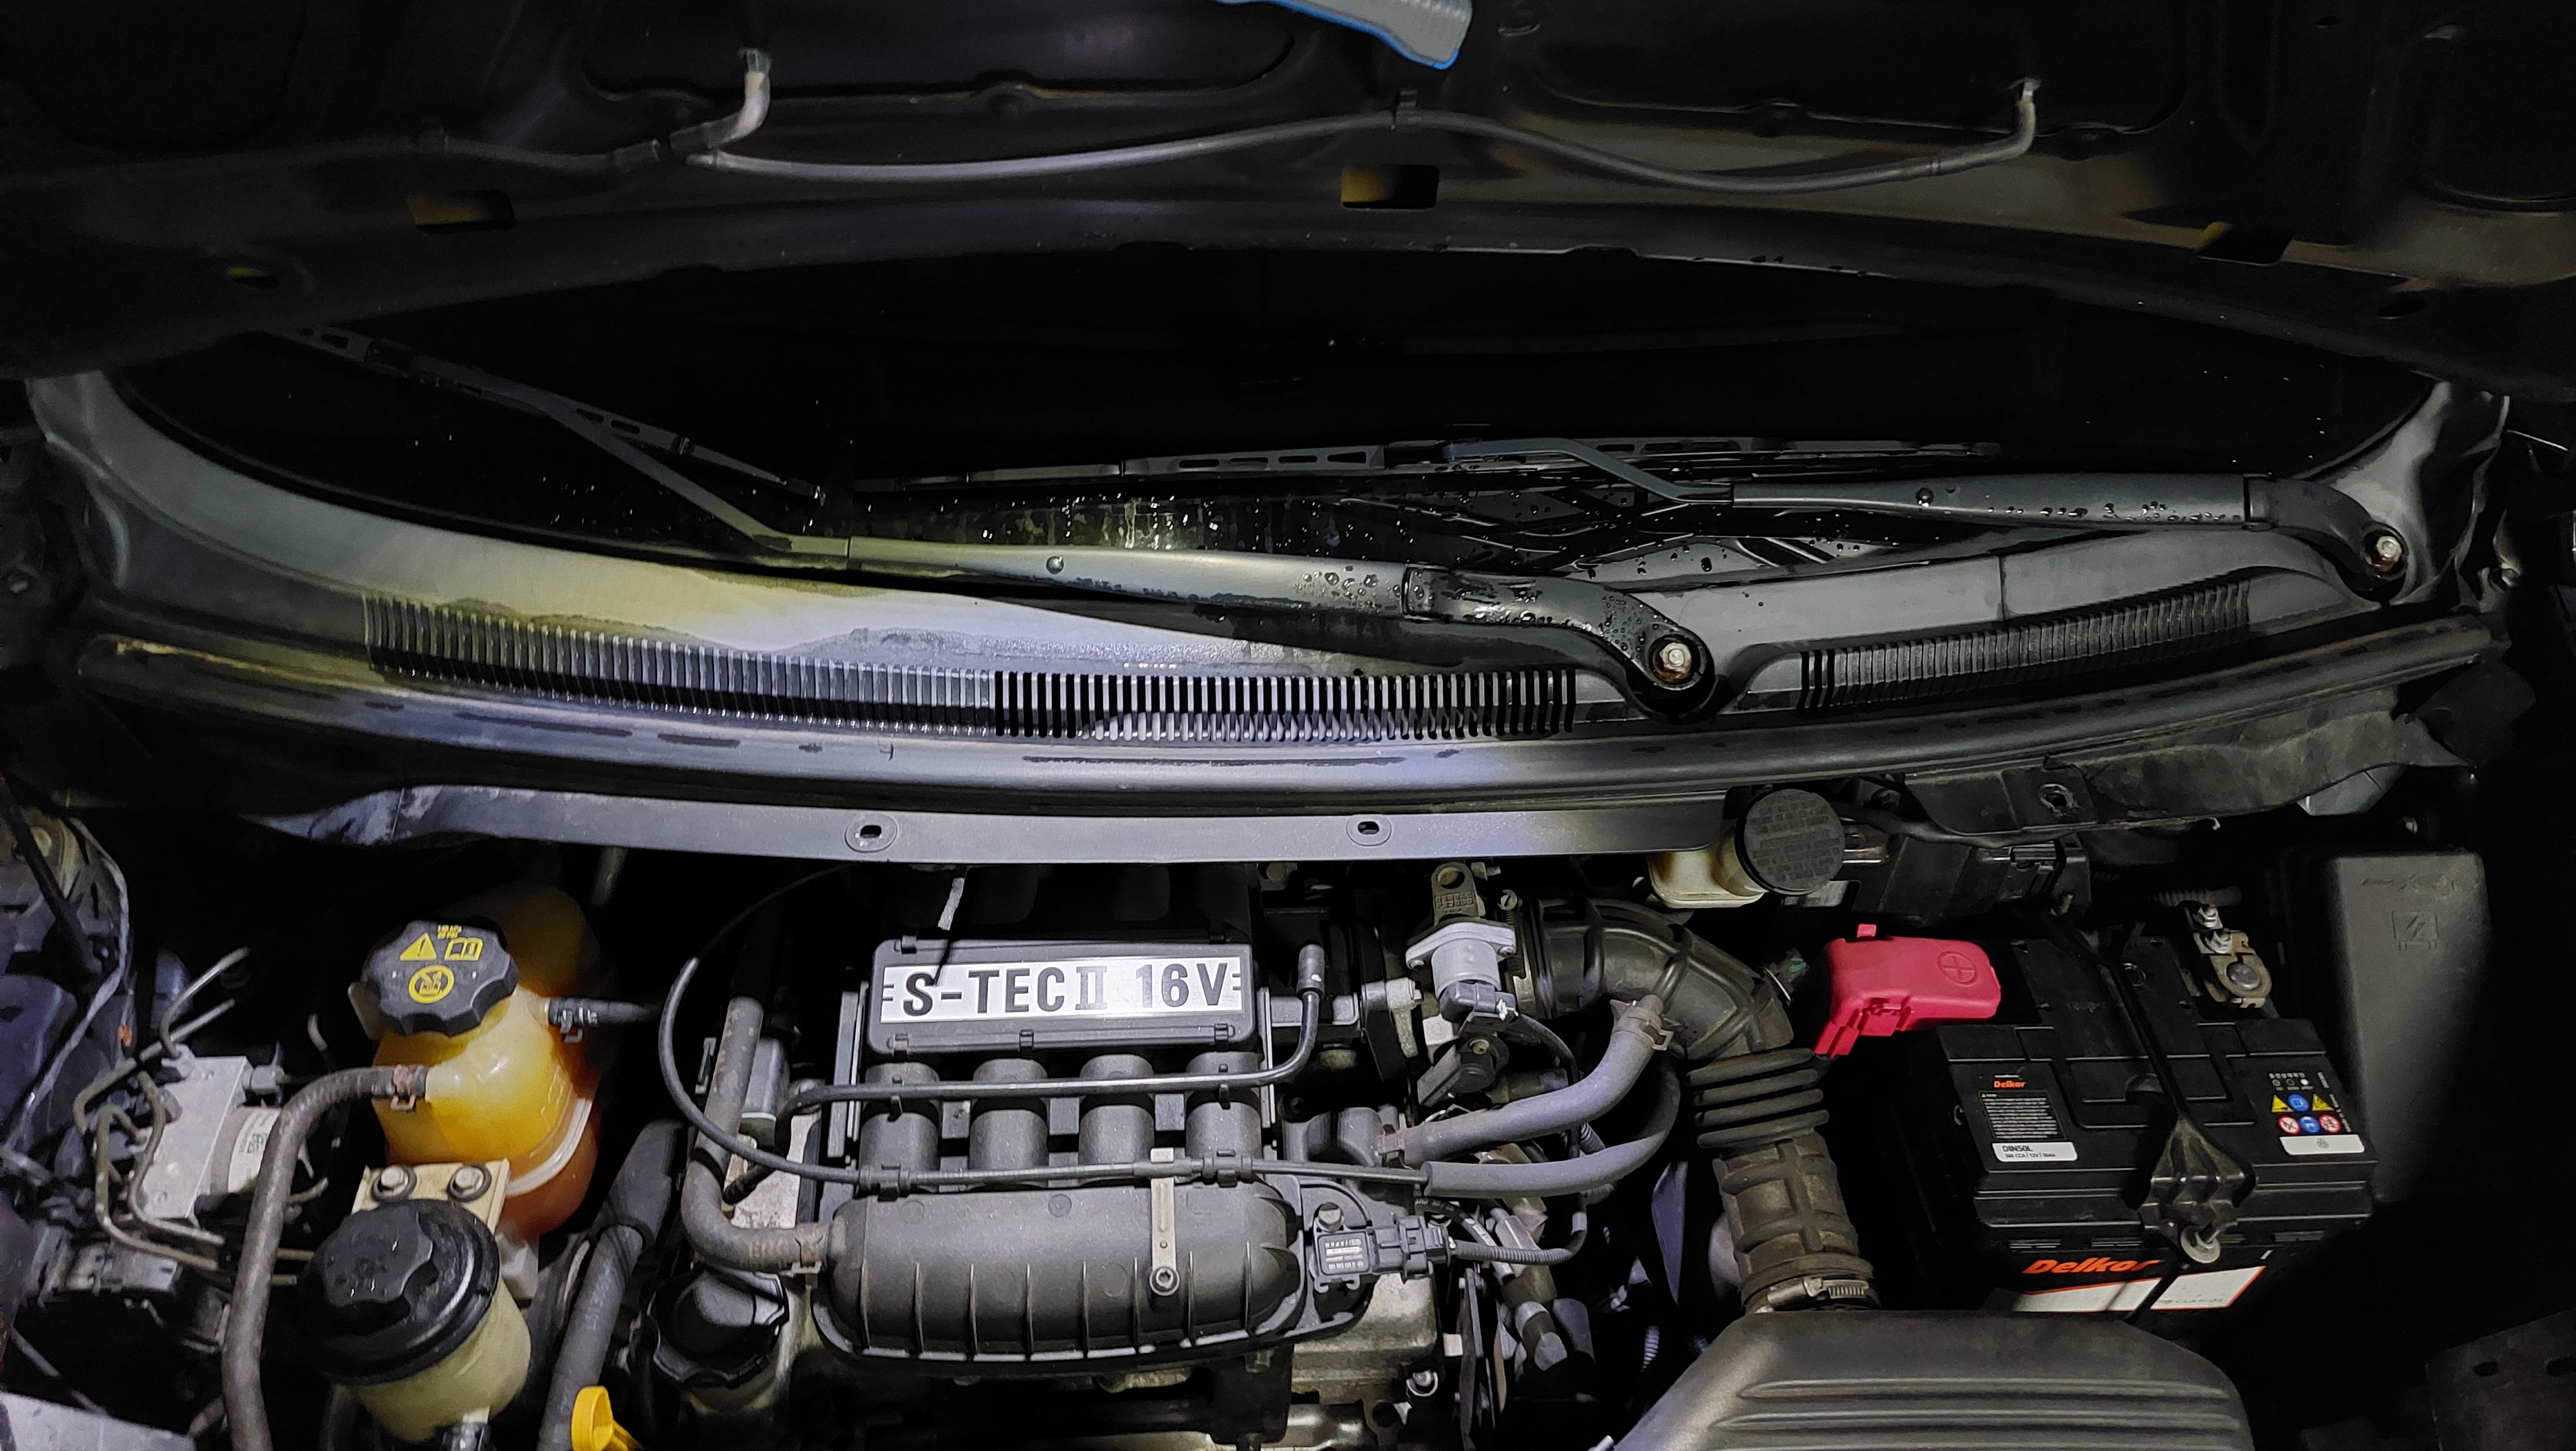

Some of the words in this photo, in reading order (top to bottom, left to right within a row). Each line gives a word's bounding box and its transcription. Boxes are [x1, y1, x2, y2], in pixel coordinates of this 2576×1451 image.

[902, 966, 1065, 1017] S-TEC
[1135, 962, 1229, 1009] 16V
[1993, 1080, 2027, 1088] Delkor
[2022, 1257, 2165, 1274] Delkor
